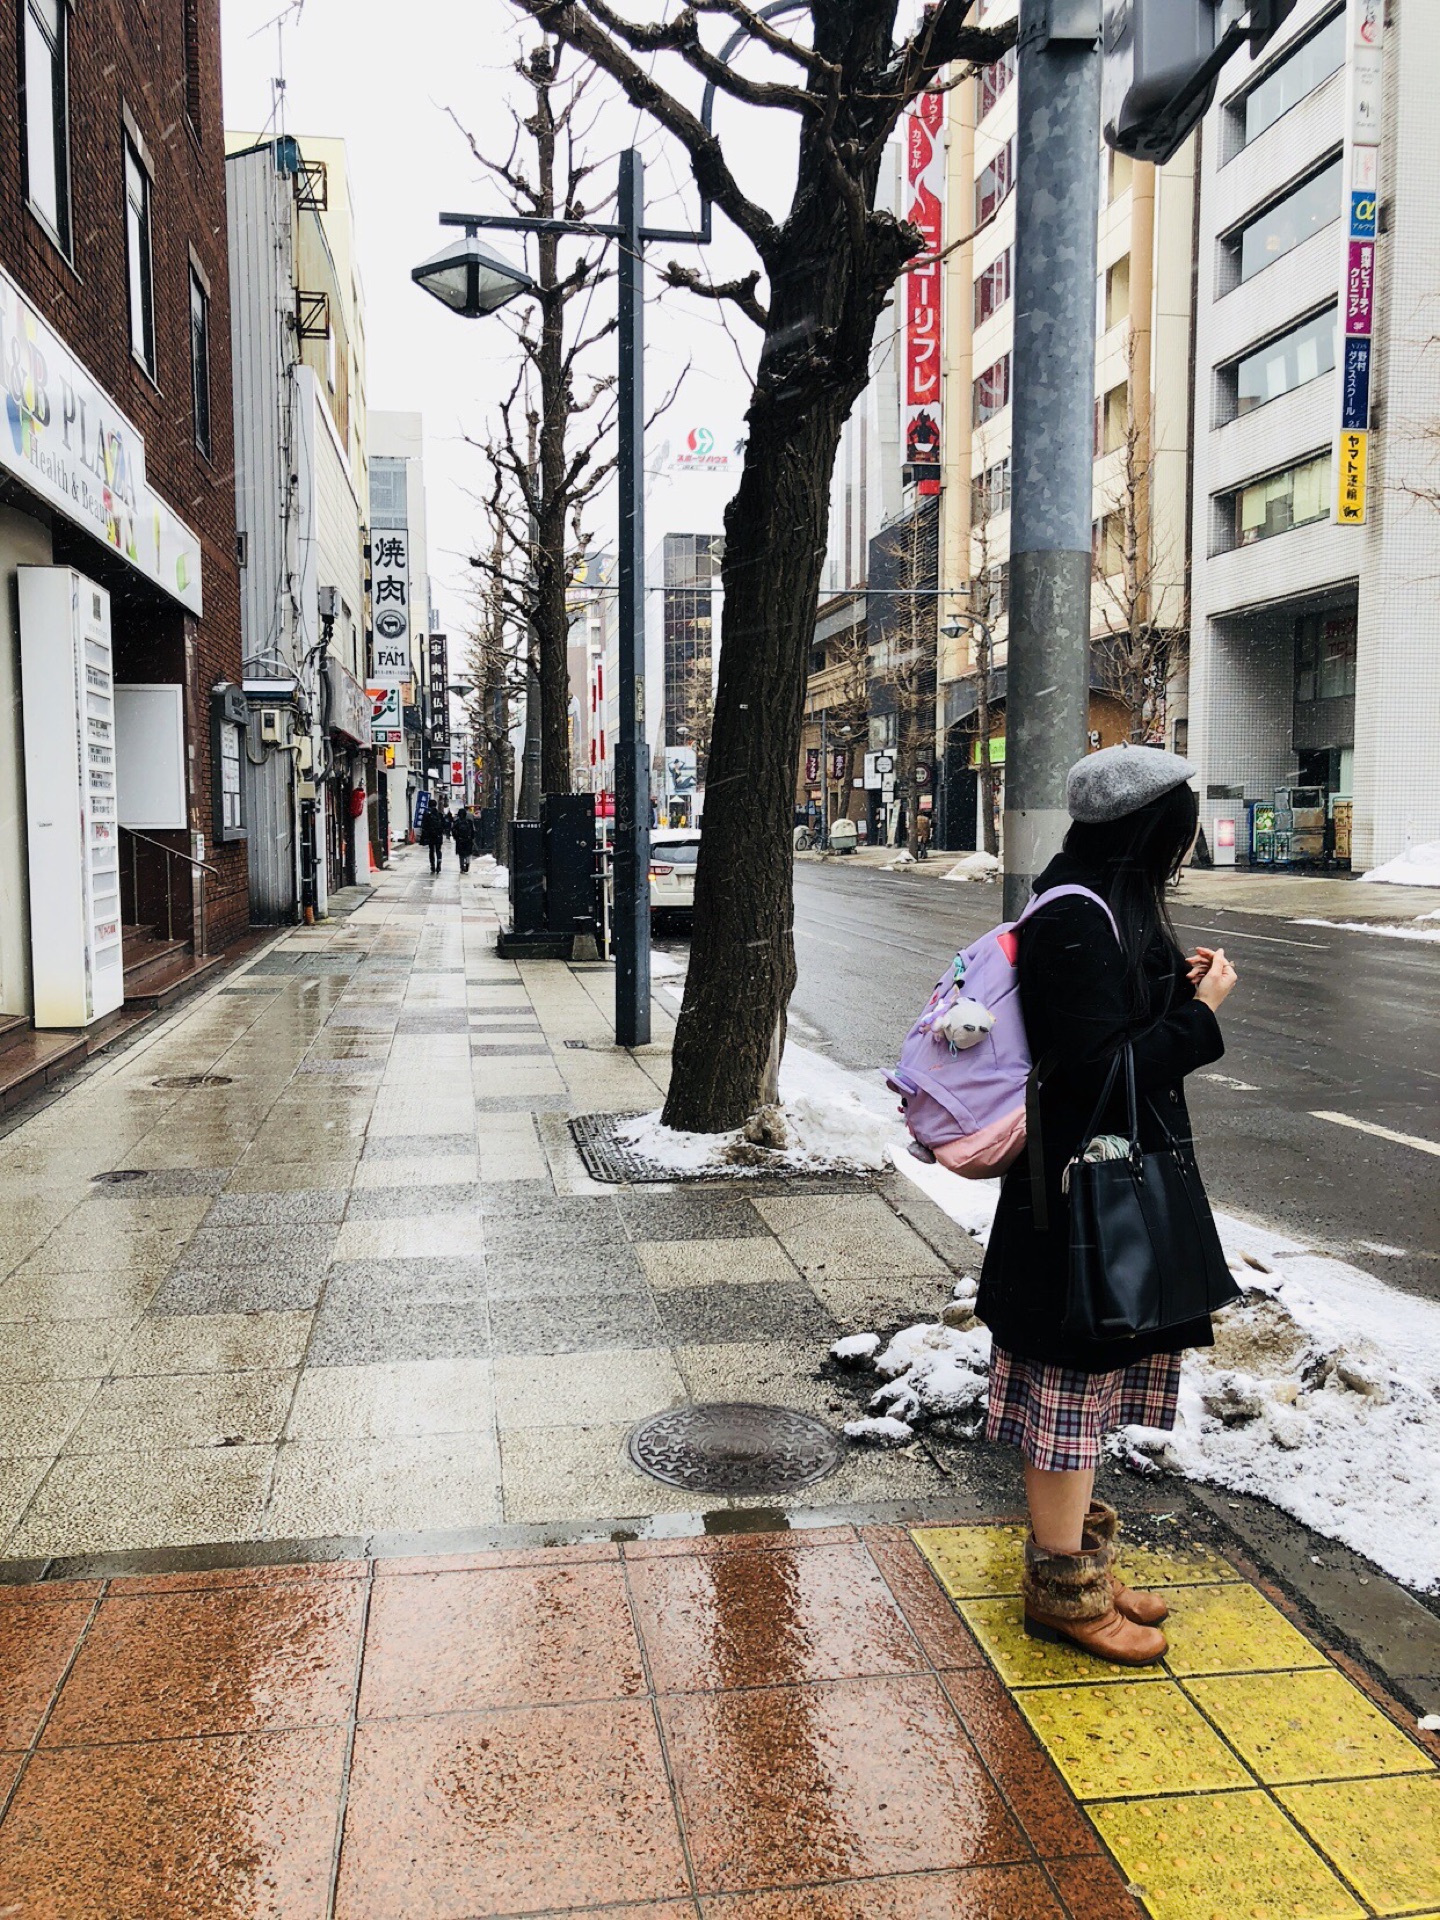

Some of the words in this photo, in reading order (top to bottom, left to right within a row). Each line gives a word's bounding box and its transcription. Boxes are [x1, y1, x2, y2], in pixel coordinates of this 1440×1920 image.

[929, 93, 939, 124] サウナ
[911, 129, 922, 169] カプセル
[1349, 268, 1360, 317] クリニック
[1346, 351, 1358, 416] ダンススクール
[1357, 351, 1367, 372] 野村
[29, 432, 69, 494] Health
[71, 472, 80, 503] &
[59, 374, 138, 515] PLAZA
[677, 455, 728, 464] スポーツハウス
[1346, 436, 1359, 501] ヤマト運輸
[374, 537, 406, 605] 焼肉
[378, 652, 405, 666] FAM
